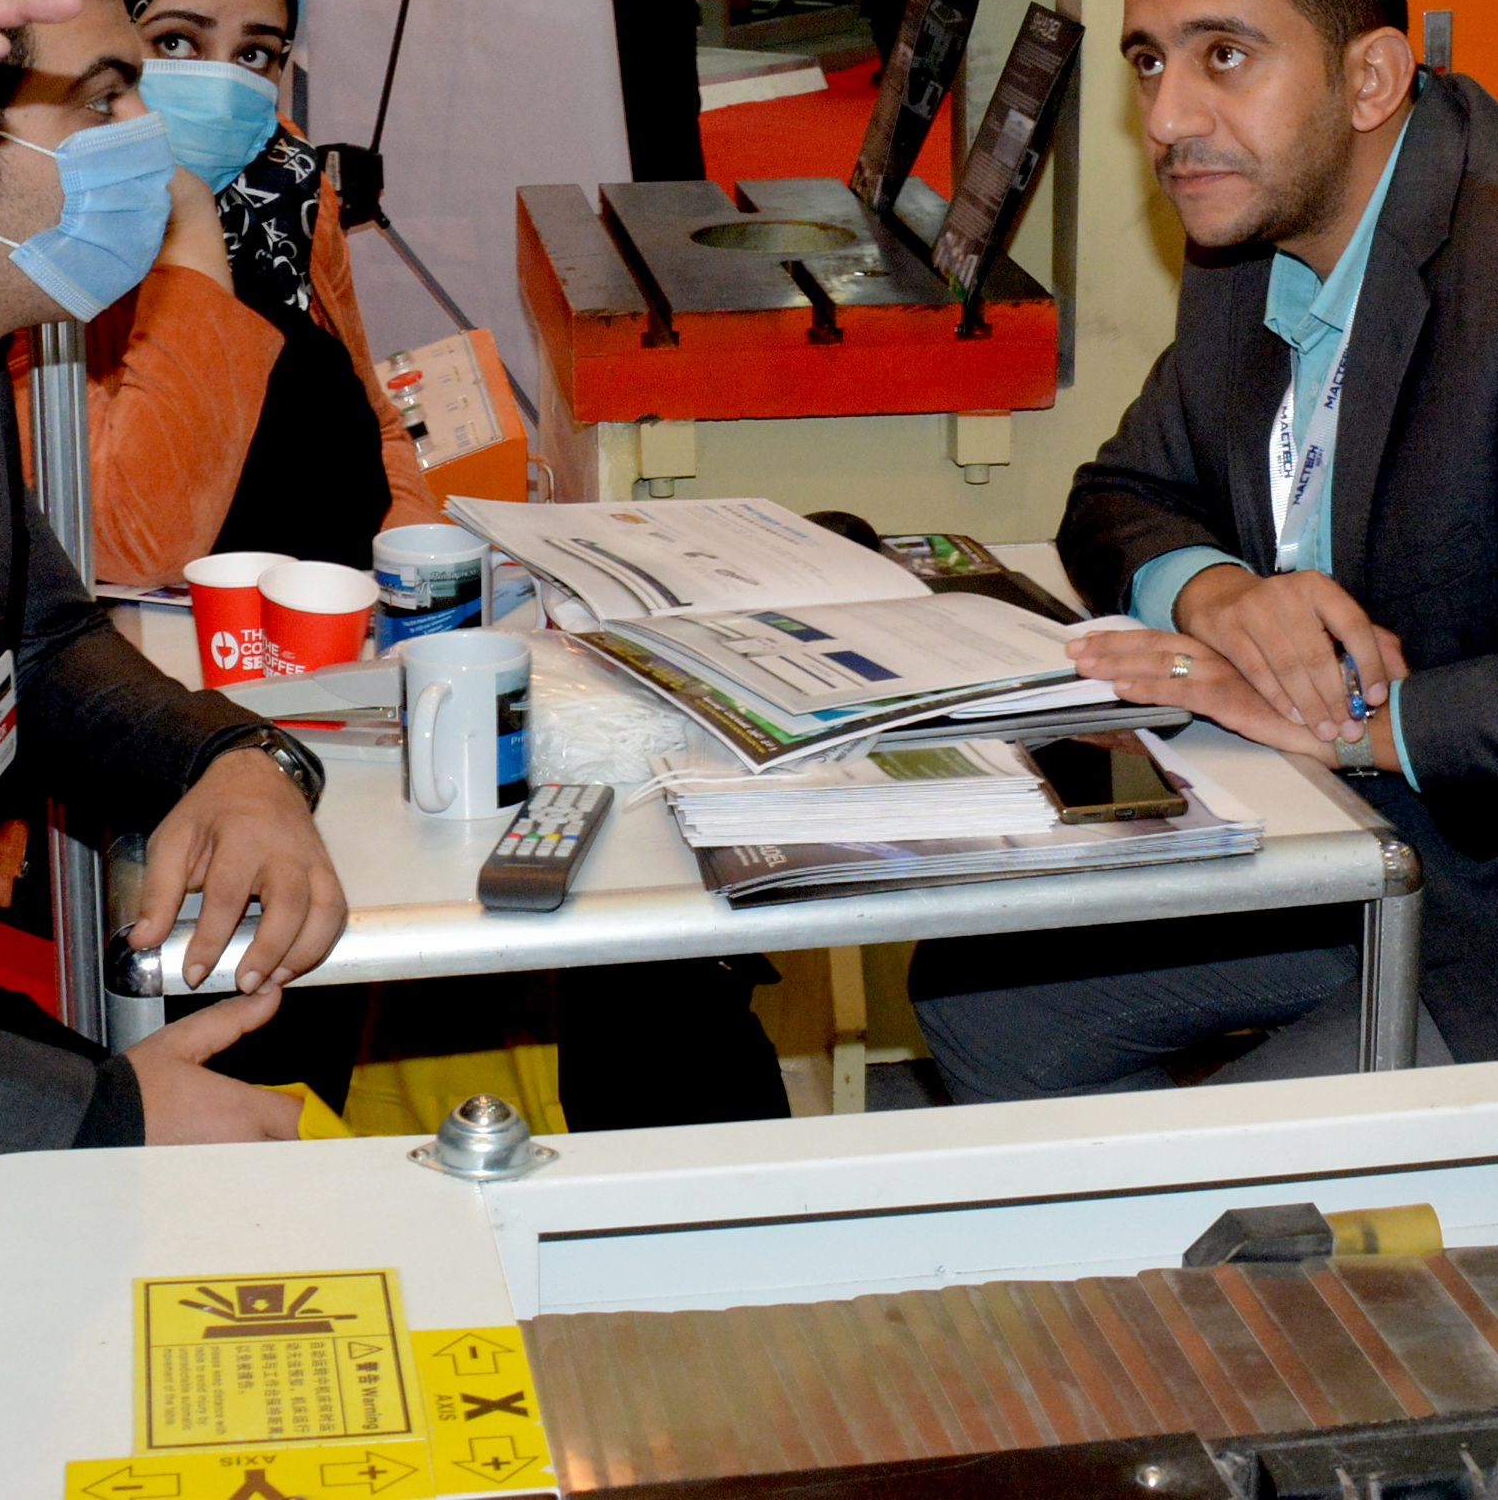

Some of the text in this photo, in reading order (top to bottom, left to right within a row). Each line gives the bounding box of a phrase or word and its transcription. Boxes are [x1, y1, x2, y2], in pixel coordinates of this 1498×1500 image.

[1280, 405, 1294, 479] MACTECH
[1292, 443, 1320, 506] MACTECH
[355, 1361, 382, 1430] 警告 Warning
[435, 1394, 458, 1422] AXIS
[460, 1389, 530, 1422] X
[219, 1454, 277, 1467] AXIS
